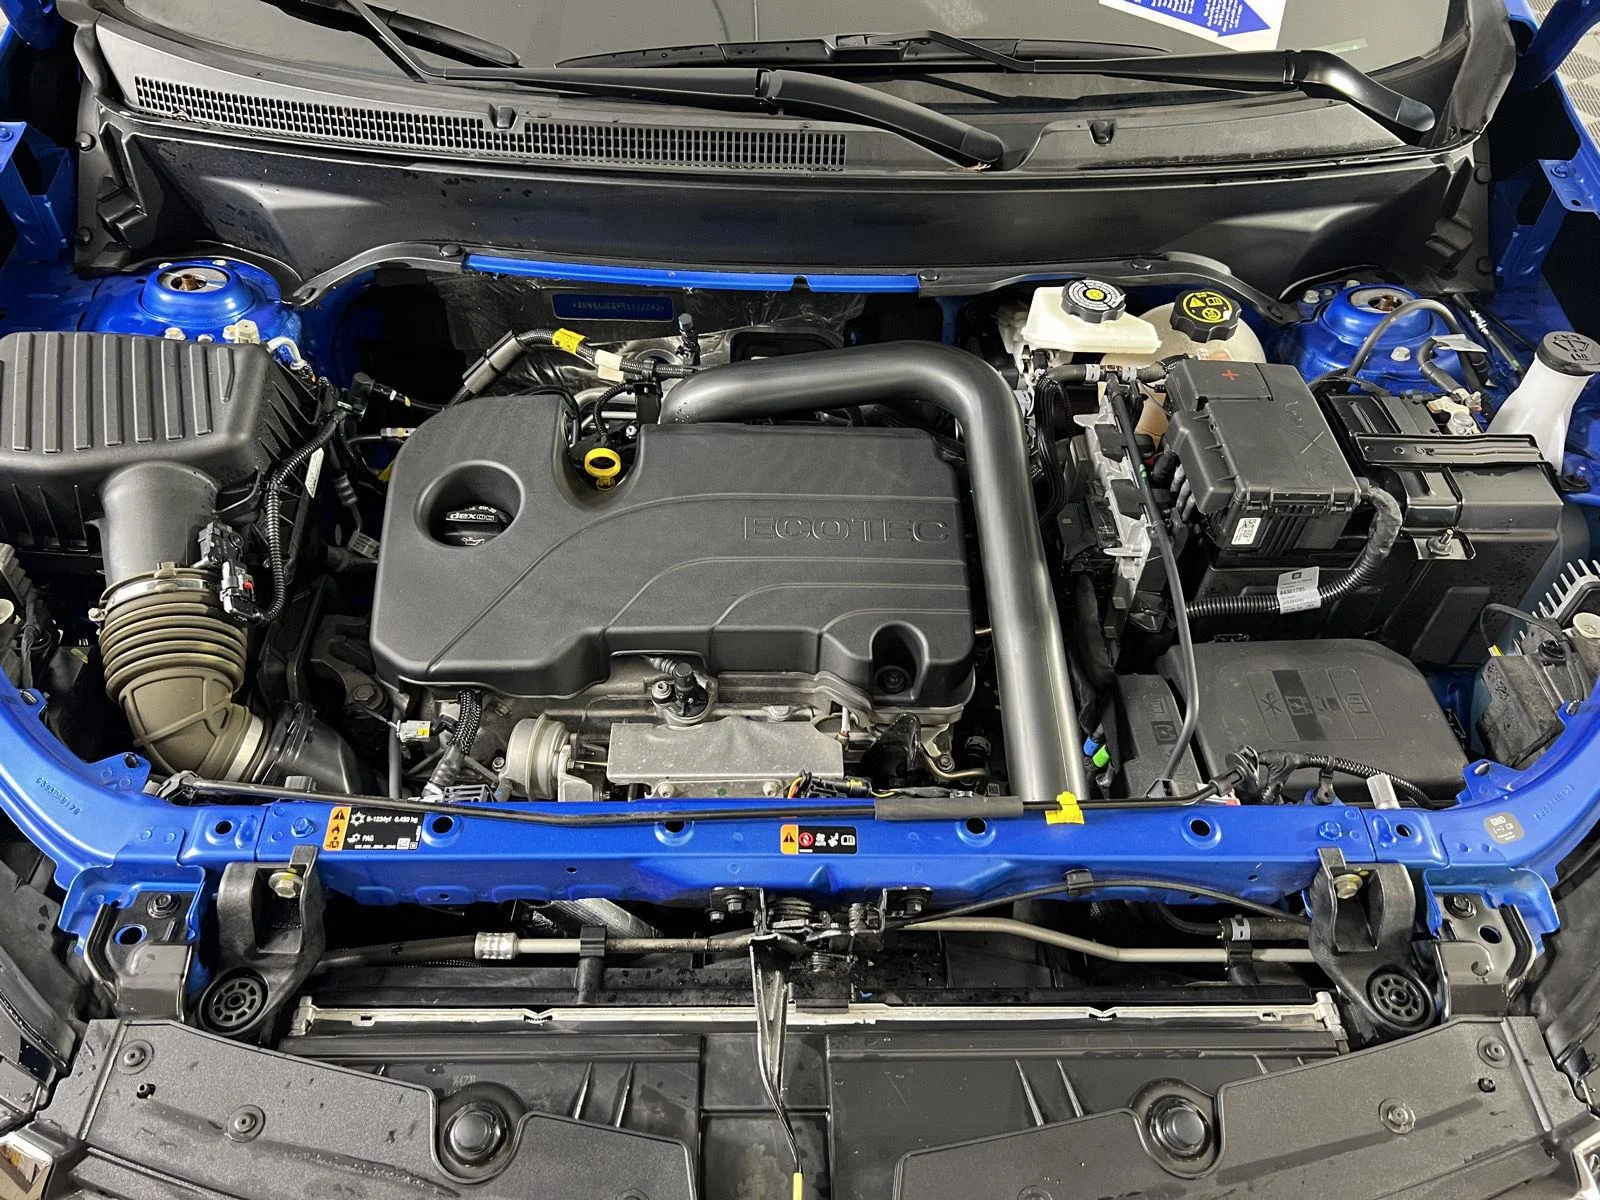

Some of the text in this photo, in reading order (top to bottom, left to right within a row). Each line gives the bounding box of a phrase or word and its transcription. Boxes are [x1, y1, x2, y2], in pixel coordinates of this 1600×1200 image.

[449, 512, 495, 521] dexos
[744, 516, 949, 543] ECOTEC
[362, 834, 375, 842] PAG
